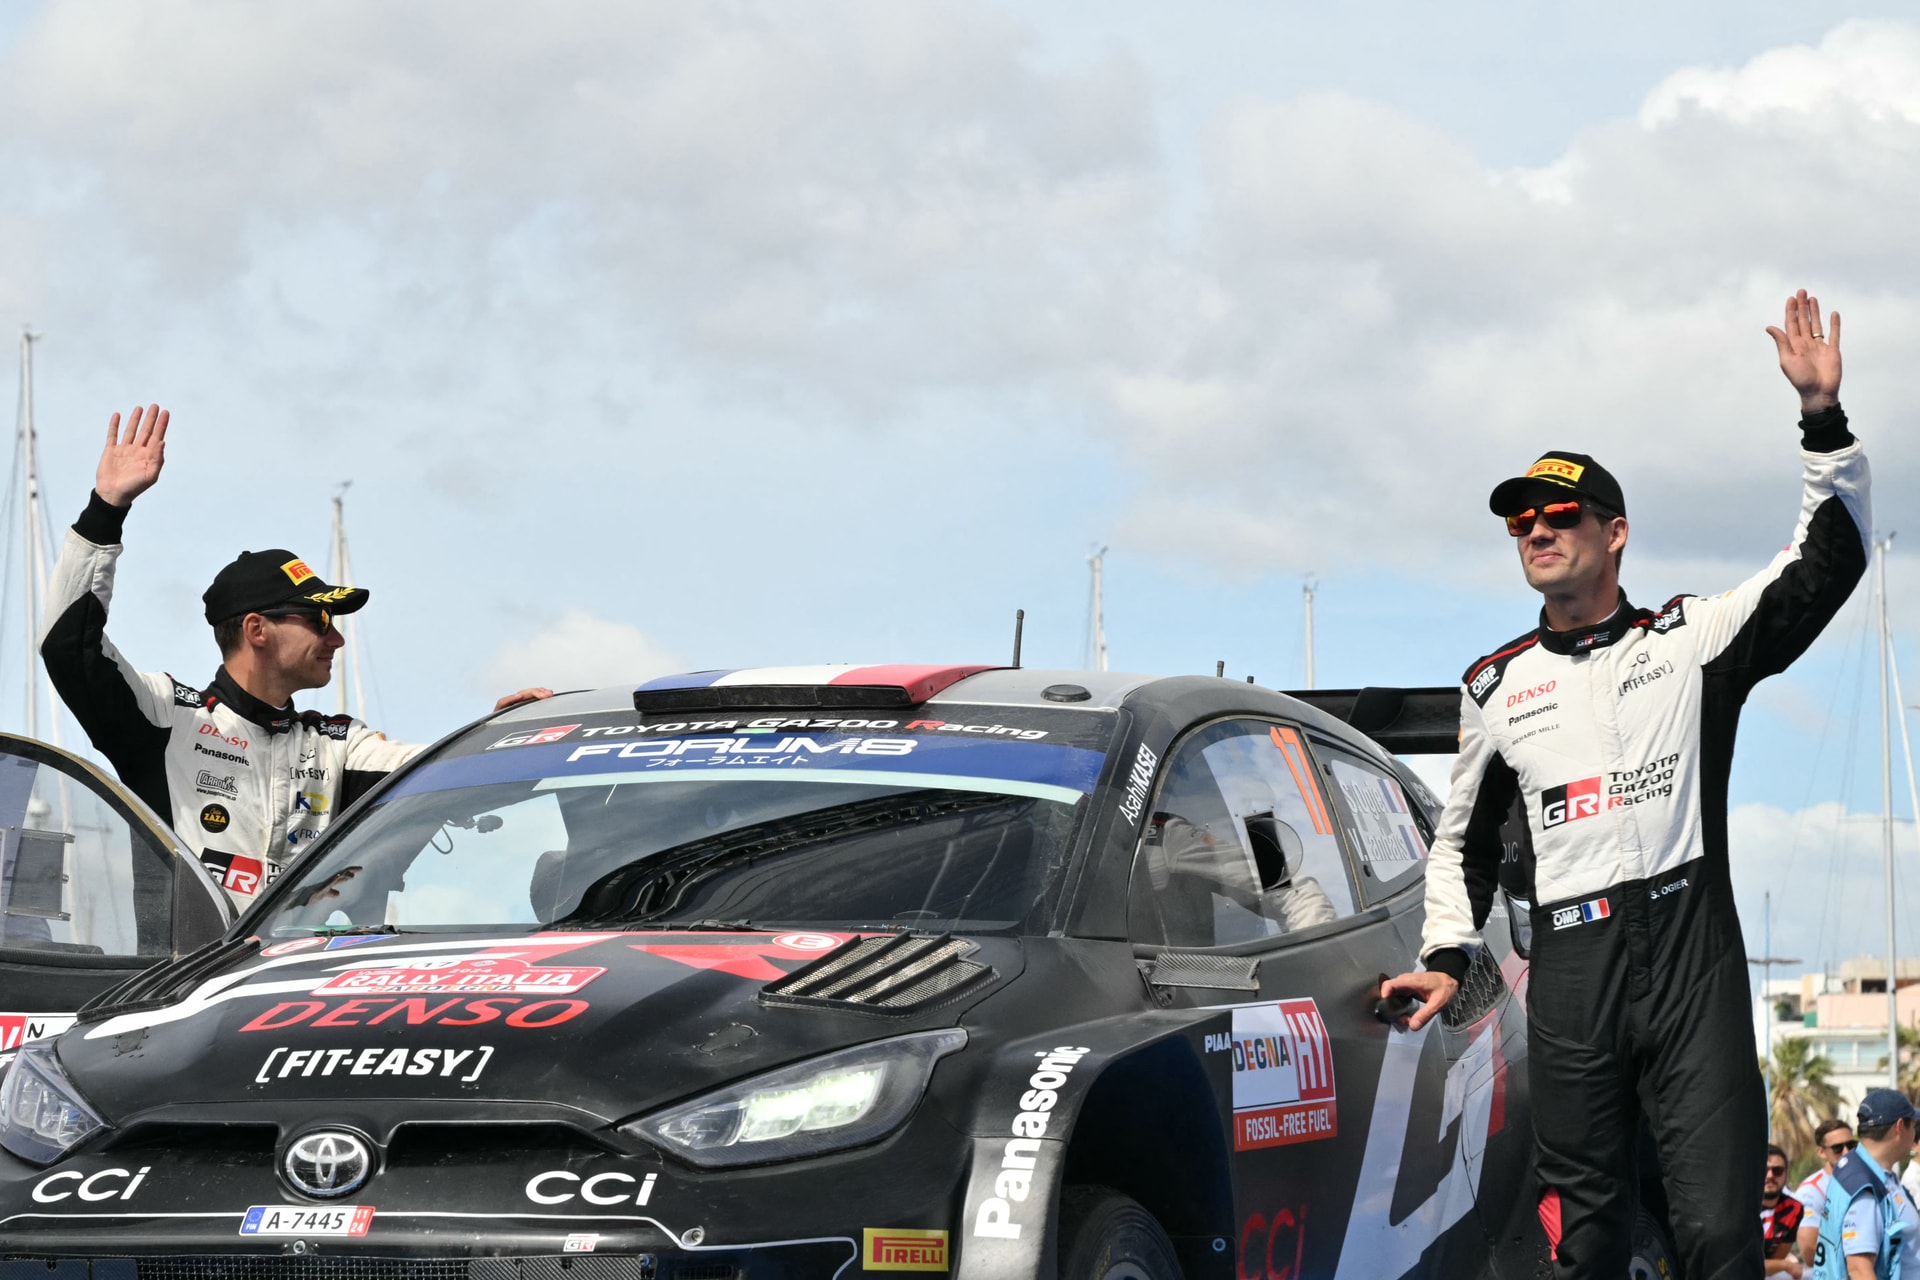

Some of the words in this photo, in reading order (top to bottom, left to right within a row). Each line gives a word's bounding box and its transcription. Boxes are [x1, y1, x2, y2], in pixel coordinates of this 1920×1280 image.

[1524, 461, 1576, 477] ELLI
[1629, 650, 1652, 668] Ci
[1471, 665, 1498, 696] OMP
[1506, 680, 1557, 708] DENSO
[1508, 702, 1560, 727] Panasonic
[1538, 723, 1561, 733] MILLE
[490, 730, 562, 750] GR
[582, 720, 737, 737] TOYOTA
[747, 718, 899, 728] GAZOO
[905, 719, 1049, 740] Racing
[194, 742, 251, 767] Panasonic
[566, 738, 918, 763] FORUM8
[645, 755, 808, 767] フォーラムエイト
[1269, 726, 1334, 835] 17
[1608, 752, 1680, 783] TOYOTA
[1608, 768, 1674, 795] GAZOO
[1118, 742, 1158, 827] AsahiKASEI
[1607, 783, 1673, 811] Racing
[203, 812, 227, 824] ZAZA
[1543, 792, 1600, 828] GR
[1650, 890, 1661, 900] S.
[1661, 878, 1690, 896] OGIER
[1551, 907, 1581, 928] OMP
[340, 974, 455, 987] RALLY
[455, 973, 574, 986] ITALIA
[238, 998, 590, 1032] DENSO
[1204, 1032, 1232, 1053] PIAA
[1232, 1035, 1293, 1073] DEGNA
[1285, 1011, 1328, 1091] HY
[254, 1046, 494, 1084] [FIT-EASY]
[1245, 1111, 1307, 1142] FOSSIL-FREE
[1308, 1108, 1332, 1133] FUEL
[972, 1045, 1091, 1240] Panasonic
[32, 1166, 151, 1203] CCi
[525, 1171, 657, 1207] CCi
[245, 1223, 258, 1231] FIN
[266, 1211, 346, 1230] A-7445
[356, 1209, 369, 1219] 11
[350, 1222, 365, 1233] 24
[872, 1236, 945, 1265] PIRELLI
